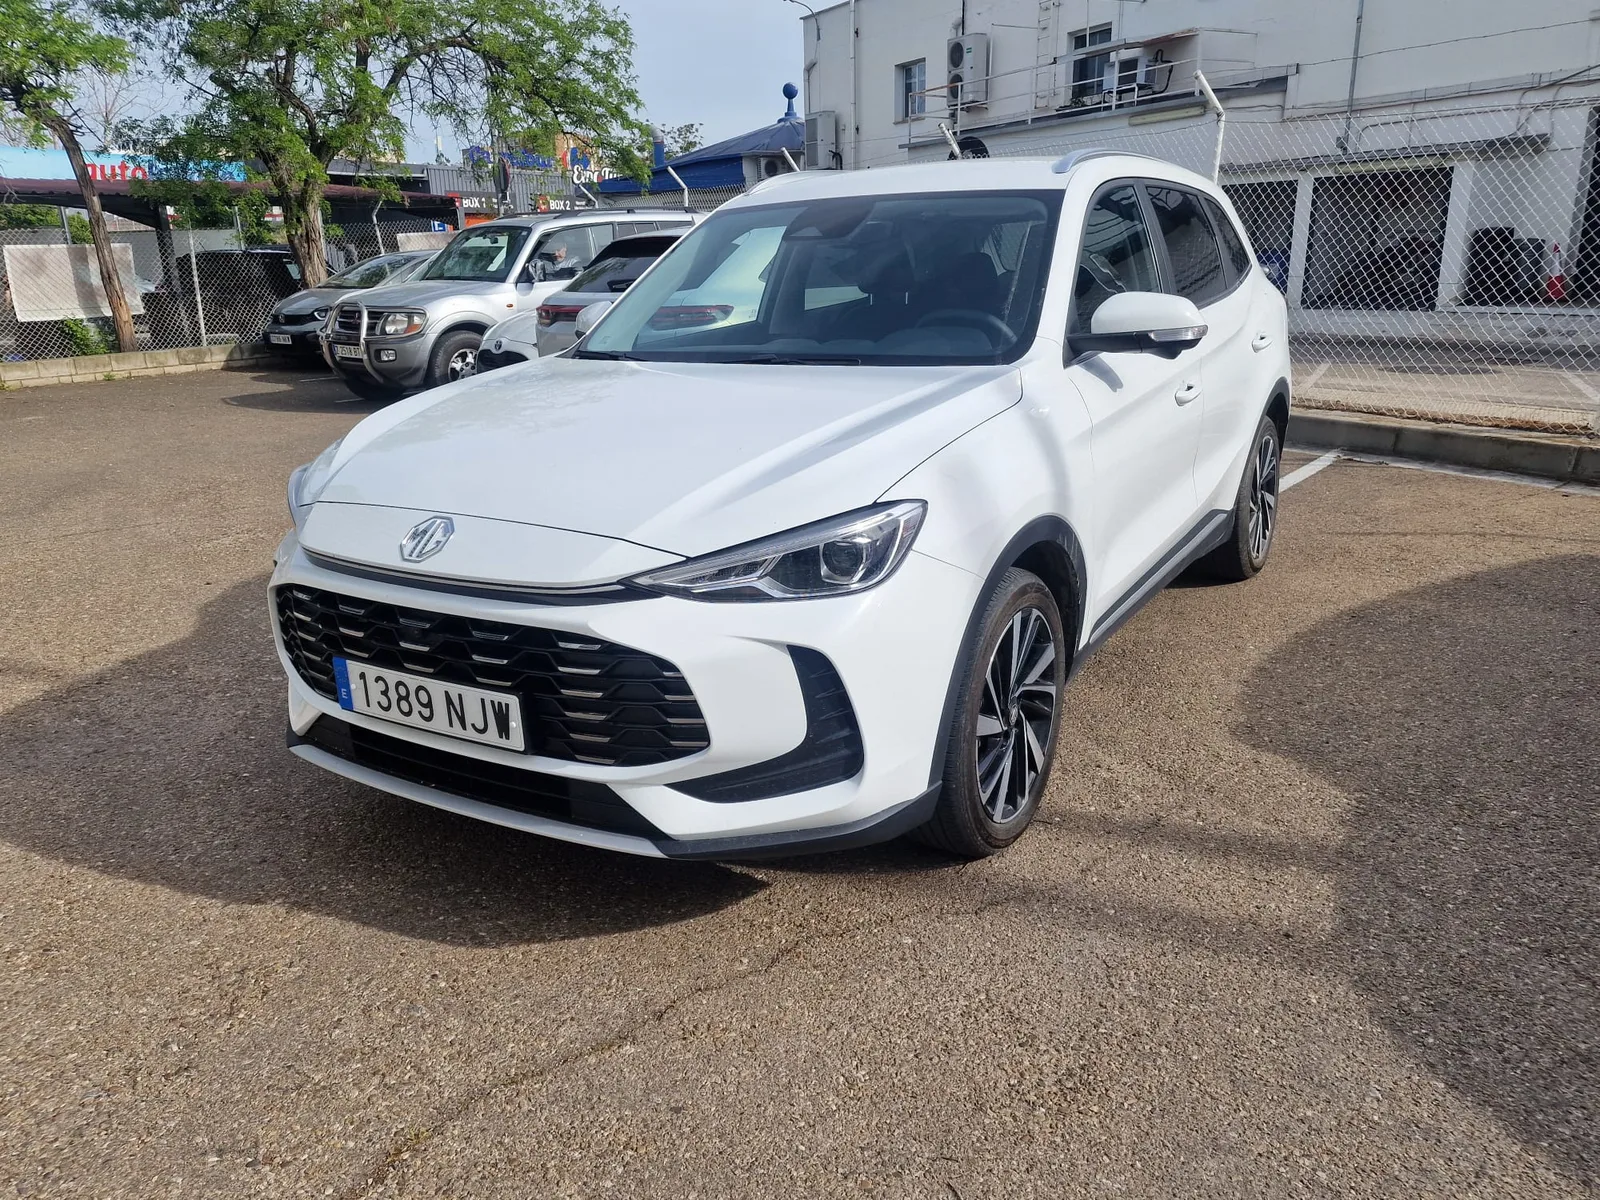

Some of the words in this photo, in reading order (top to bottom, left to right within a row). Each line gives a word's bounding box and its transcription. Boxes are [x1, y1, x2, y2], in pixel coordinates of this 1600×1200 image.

[463, 197, 481, 208] BOX
[549, 200, 565, 210] BOX
[565, 200, 571, 210] 2
[401, 516, 455, 562] MG
[358, 671, 434, 723] 1389
[444, 690, 510, 741] NJW
